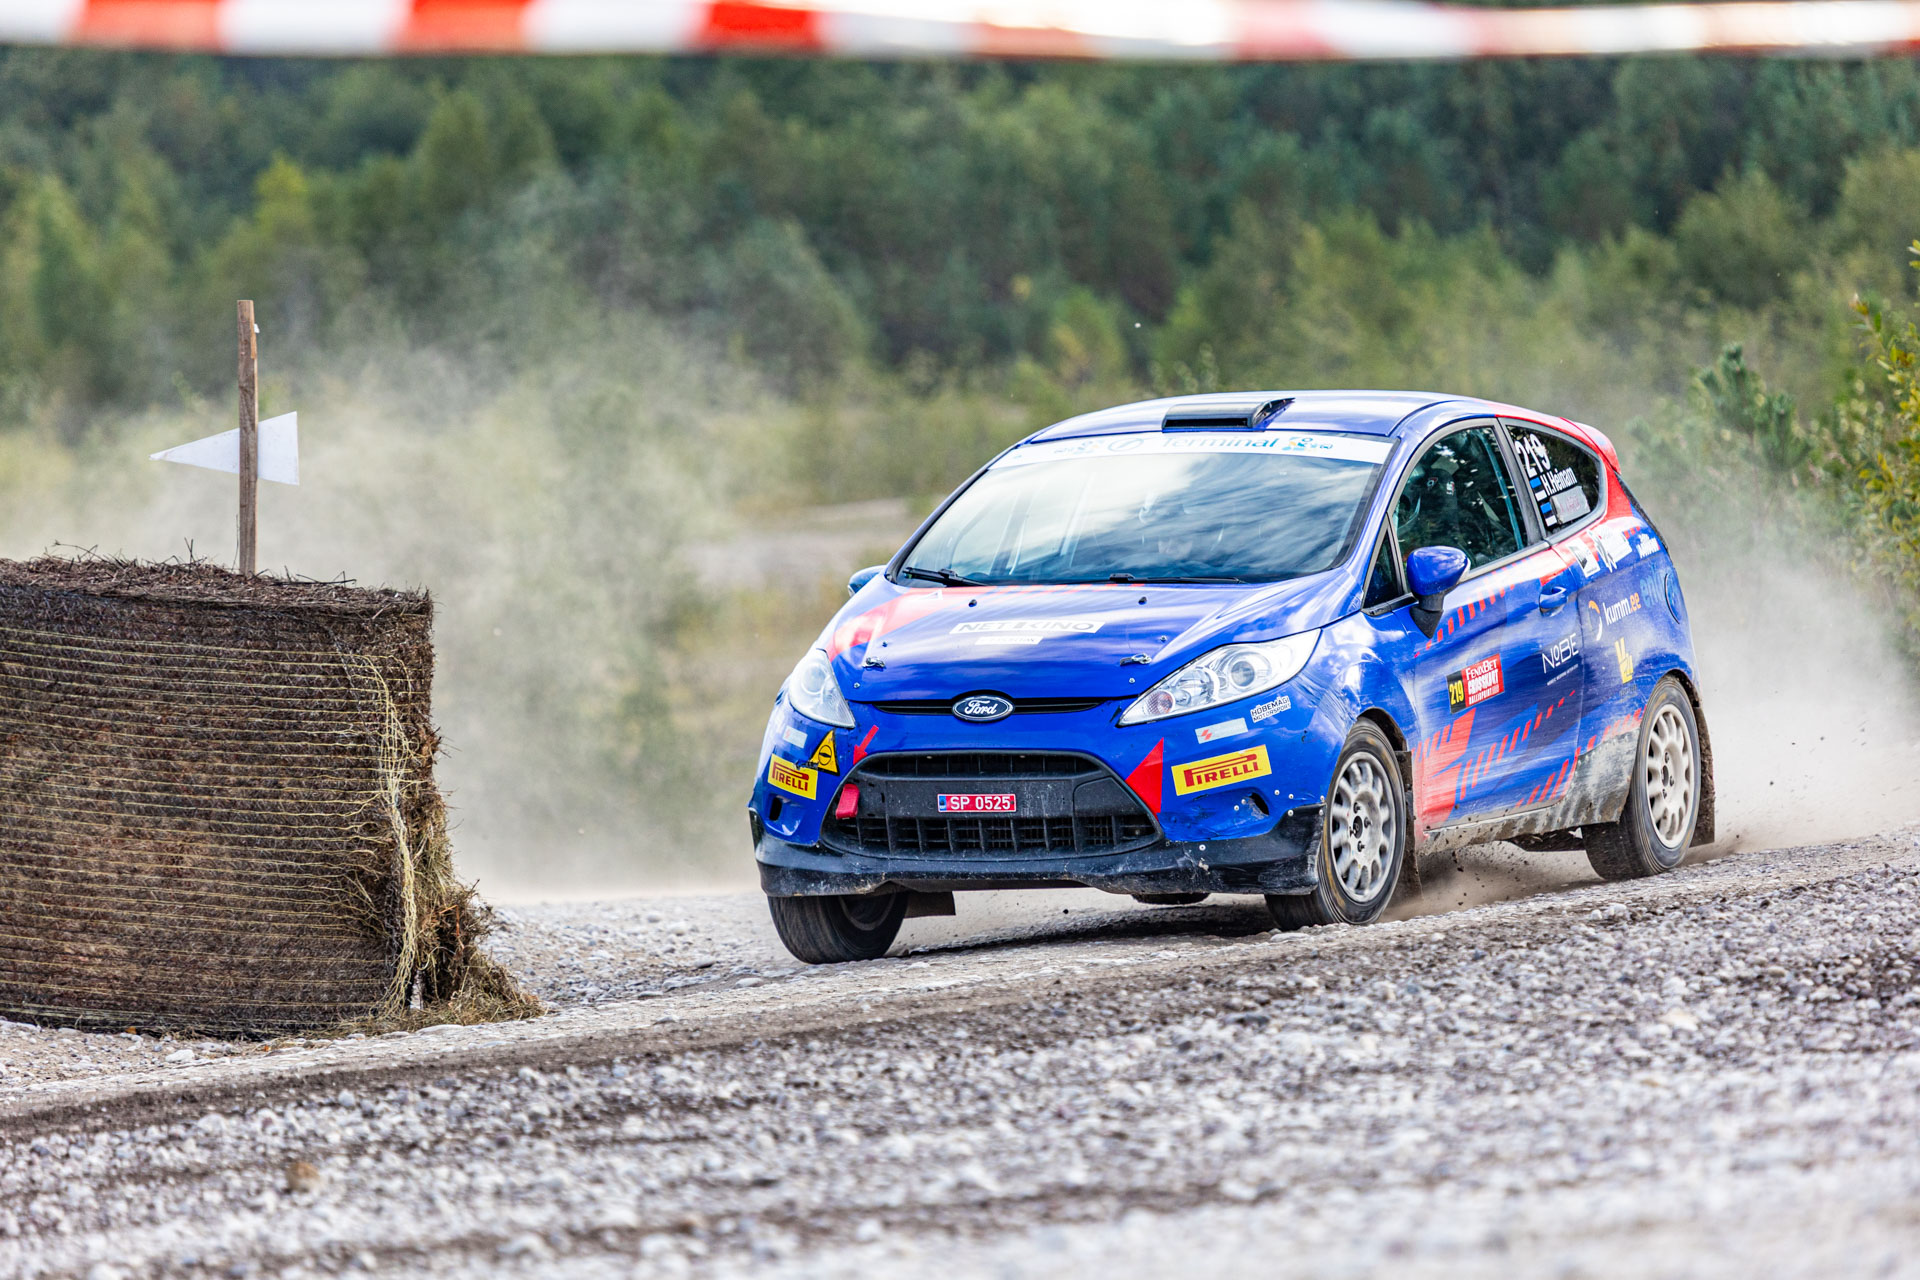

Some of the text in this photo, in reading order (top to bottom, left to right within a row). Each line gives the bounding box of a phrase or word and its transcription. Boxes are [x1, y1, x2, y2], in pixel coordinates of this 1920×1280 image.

[1162, 436, 1280, 449] Terminal
[1515, 433, 1551, 479] 219
[1602, 592, 1642, 626] kumm.ee
[1449, 679, 1465, 705] 219
[964, 699, 998, 715] Ford
[1253, 703, 1291, 722] MOTORSPORT
[772, 760, 810, 792] PIRELLI
[1183, 753, 1259, 788] PIRELLI
[950, 796, 1011, 810] SP 0525
